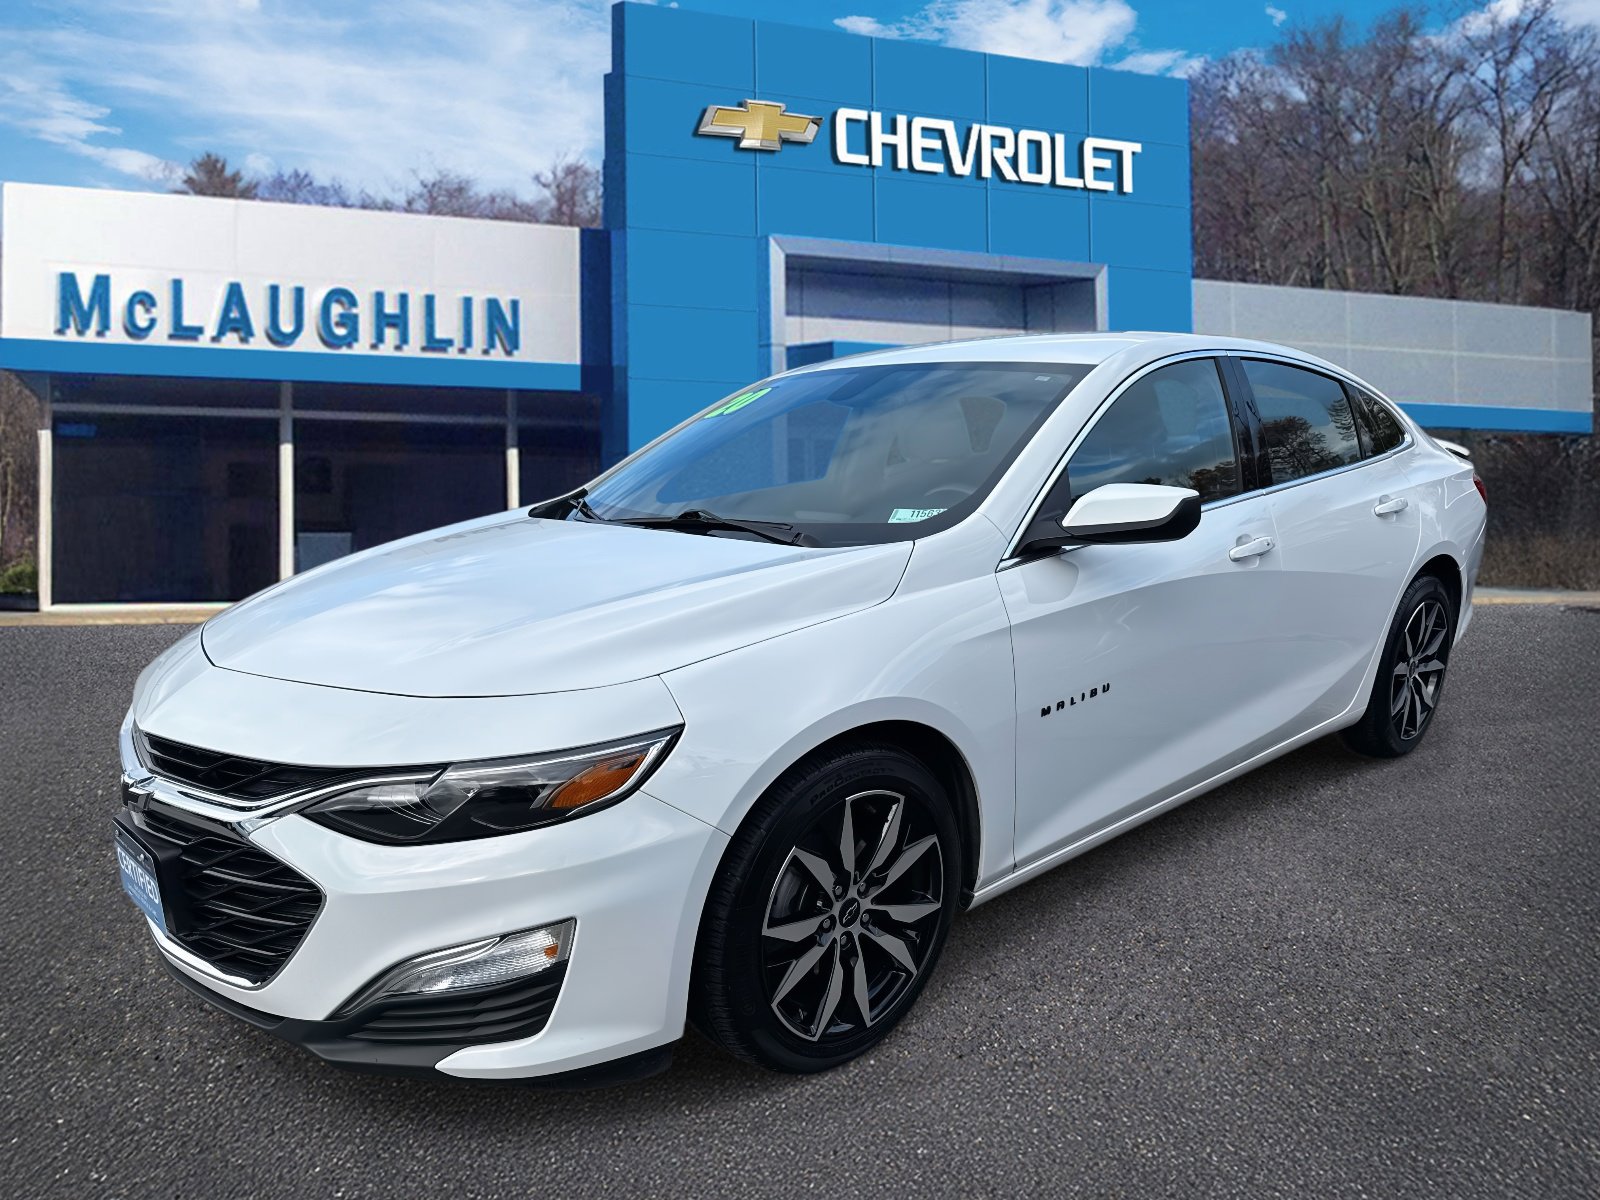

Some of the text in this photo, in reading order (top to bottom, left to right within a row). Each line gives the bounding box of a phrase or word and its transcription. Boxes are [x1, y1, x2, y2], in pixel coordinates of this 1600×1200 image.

[835, 107, 1142, 193] CHEVROLET
[56, 271, 520, 356] McLAUGHLIN
[1041, 683, 1110, 717] MALIBU
